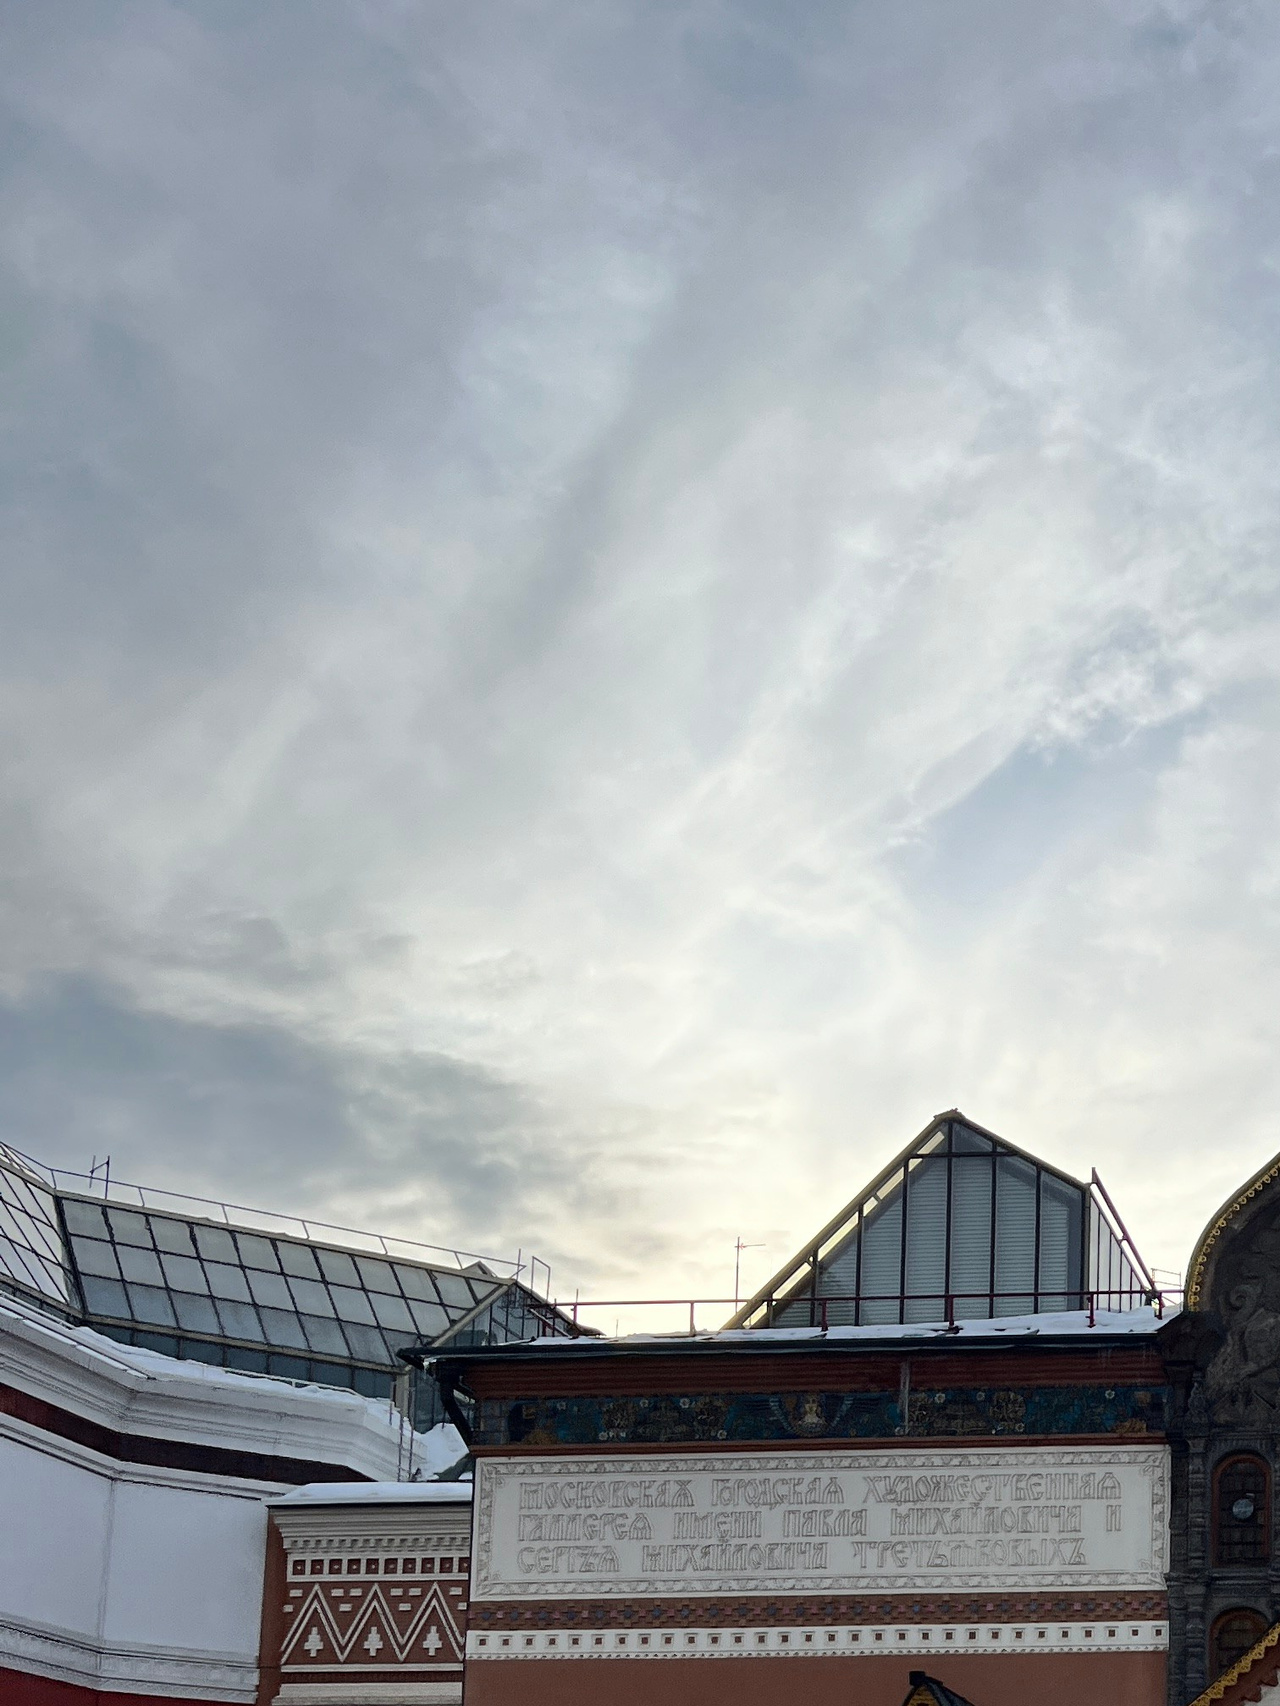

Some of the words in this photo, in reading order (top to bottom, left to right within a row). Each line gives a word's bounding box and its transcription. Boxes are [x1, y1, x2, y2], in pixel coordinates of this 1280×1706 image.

[520, 1480, 695, 1509] МОСКОВСКАЯ
[712, 1477, 844, 1510] ГОРОДСКАЯ
[862, 1472, 1122, 1506] ХУДОЖЕСТВЕННАЯ
[518, 1513, 652, 1541] ГАЛЛЕРЕЯ
[674, 1511, 761, 1539] ИМЕНИ
[783, 1509, 868, 1537] ПАВЛА
[890, 1502, 1081, 1536] МИХАЙЛОВИЧА
[1106, 1504, 1122, 1531] И
[642, 1539, 828, 1572] МИХАЙЛОВИЧА
